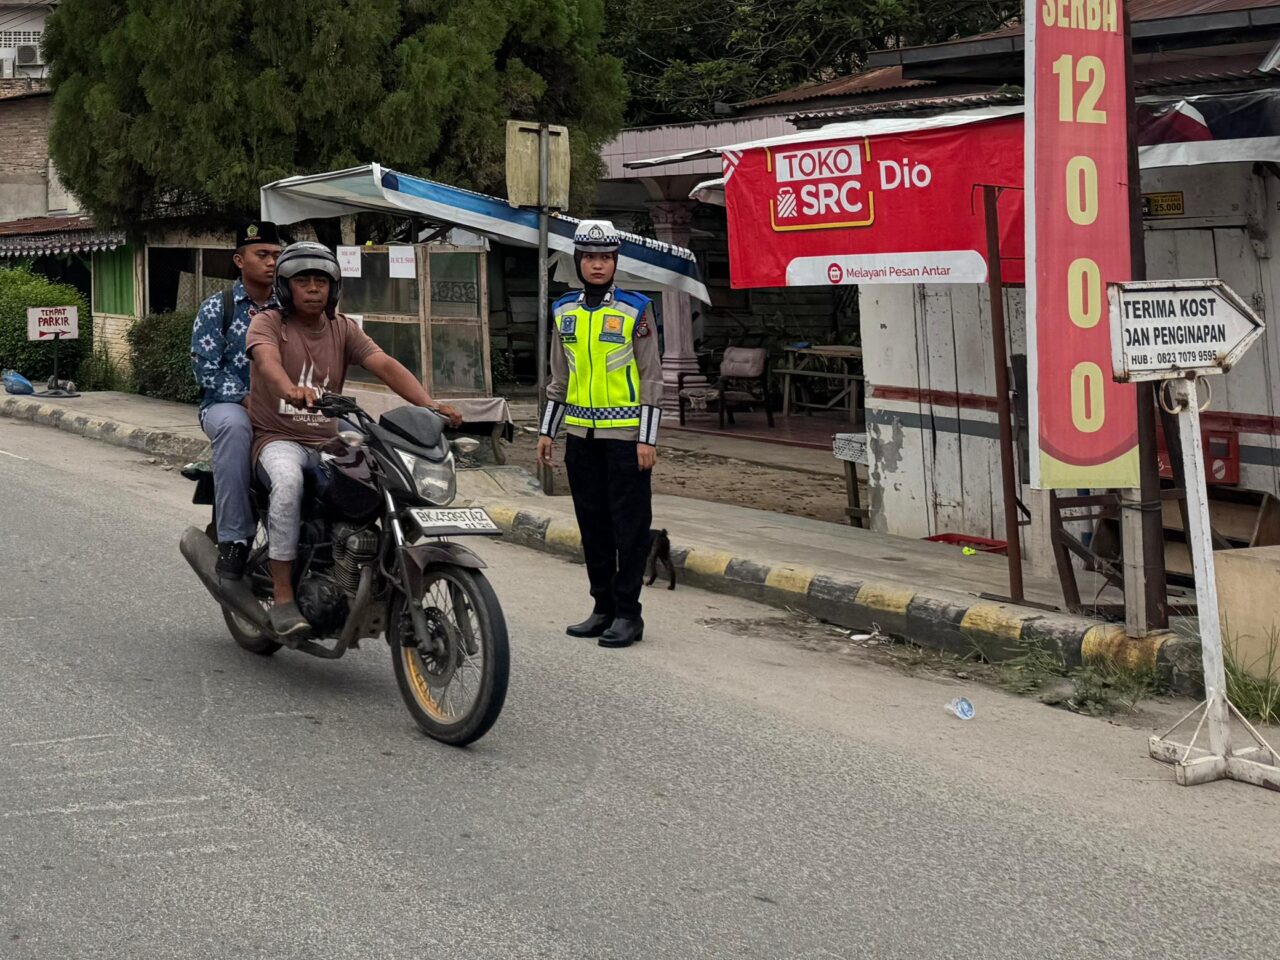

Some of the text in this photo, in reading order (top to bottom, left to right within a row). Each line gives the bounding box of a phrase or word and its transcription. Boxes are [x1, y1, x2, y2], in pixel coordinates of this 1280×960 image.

[782, 148, 852, 179] TOKO
[878, 157, 932, 190] Dio
[800, 180, 863, 216] SRC
[645, 237, 669, 253] BATU
[671, 244, 697, 264] BARA
[846, 265, 952, 280] Melayani Pesan Antar
[1124, 298, 1216, 320] TERIMA KOST
[38, 316, 70, 328] PARKIR
[1125, 324, 1226, 346] DAN PENGINAPAN
[1157, 352, 1176, 364] 0823
[1178, 351, 1197, 362] 7079
[1198, 350, 1217, 362] 9595
[416, 511, 432, 522] BK
